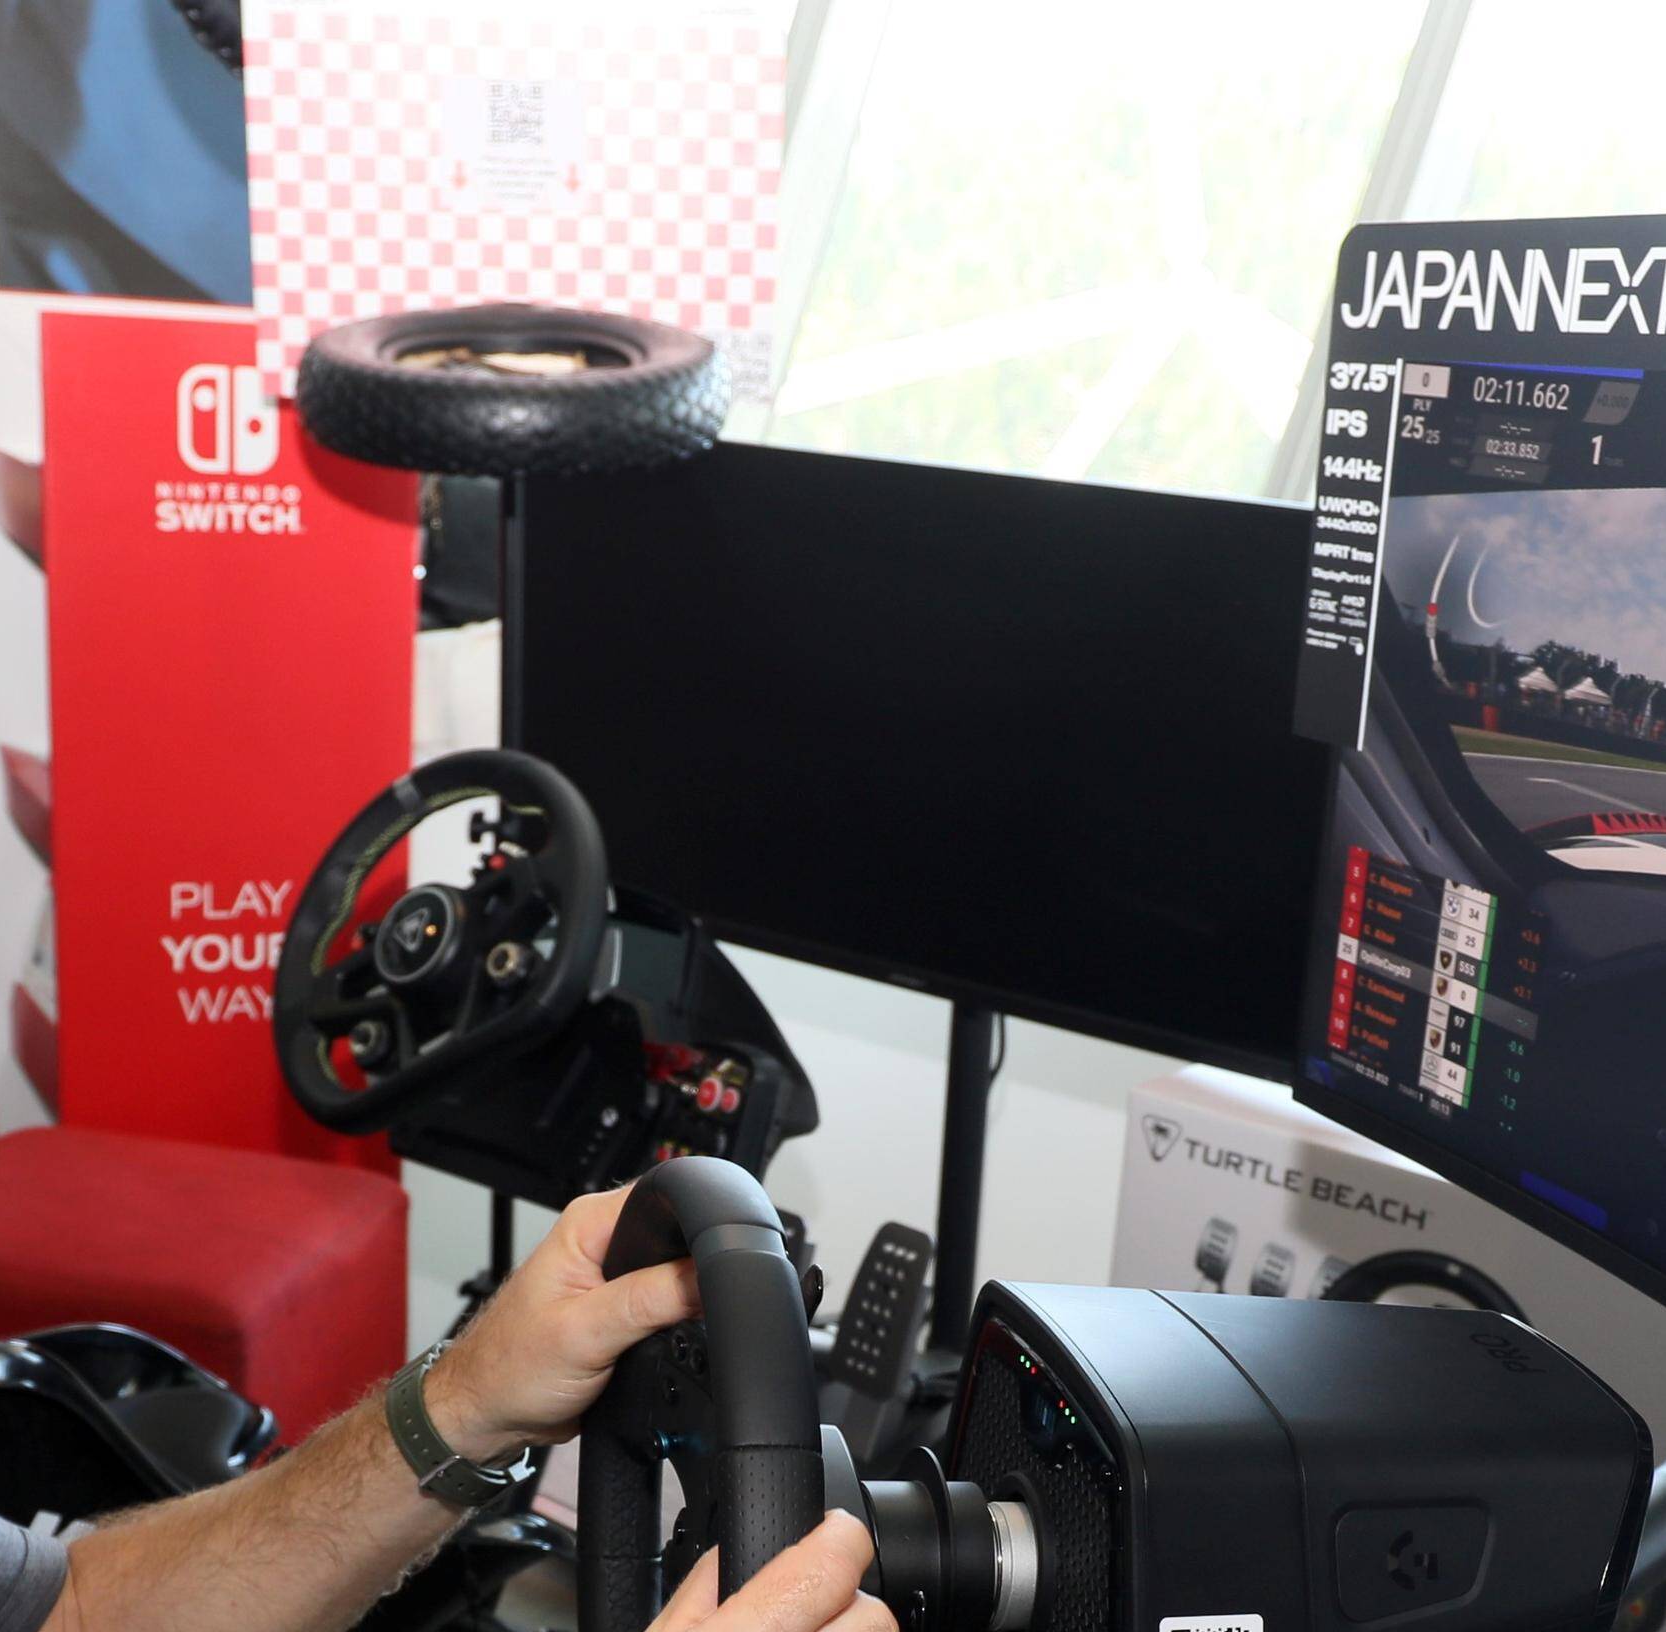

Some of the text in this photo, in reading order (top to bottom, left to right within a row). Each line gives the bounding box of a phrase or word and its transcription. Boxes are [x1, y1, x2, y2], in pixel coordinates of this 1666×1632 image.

[1330, 362, 1395, 393] 37.5"
[1473, 376, 1570, 411] 02:11.662
[1325, 408, 1368, 437] IPS
[1485, 439, 1541, 460] 02:33.852
[1591, 435, 1604, 465] 1
[1323, 456, 1382, 482] 144Hz
[156, 481, 301, 505] NINTENDO
[154, 501, 302, 535] SWITCH
[170, 880, 293, 920] PLAY
[1469, 907, 1480, 921] 34
[1465, 936, 1477, 949] 25
[1459, 961, 1476, 976] 555
[1184, 1139, 1429, 1230] TURTLE BEACH
